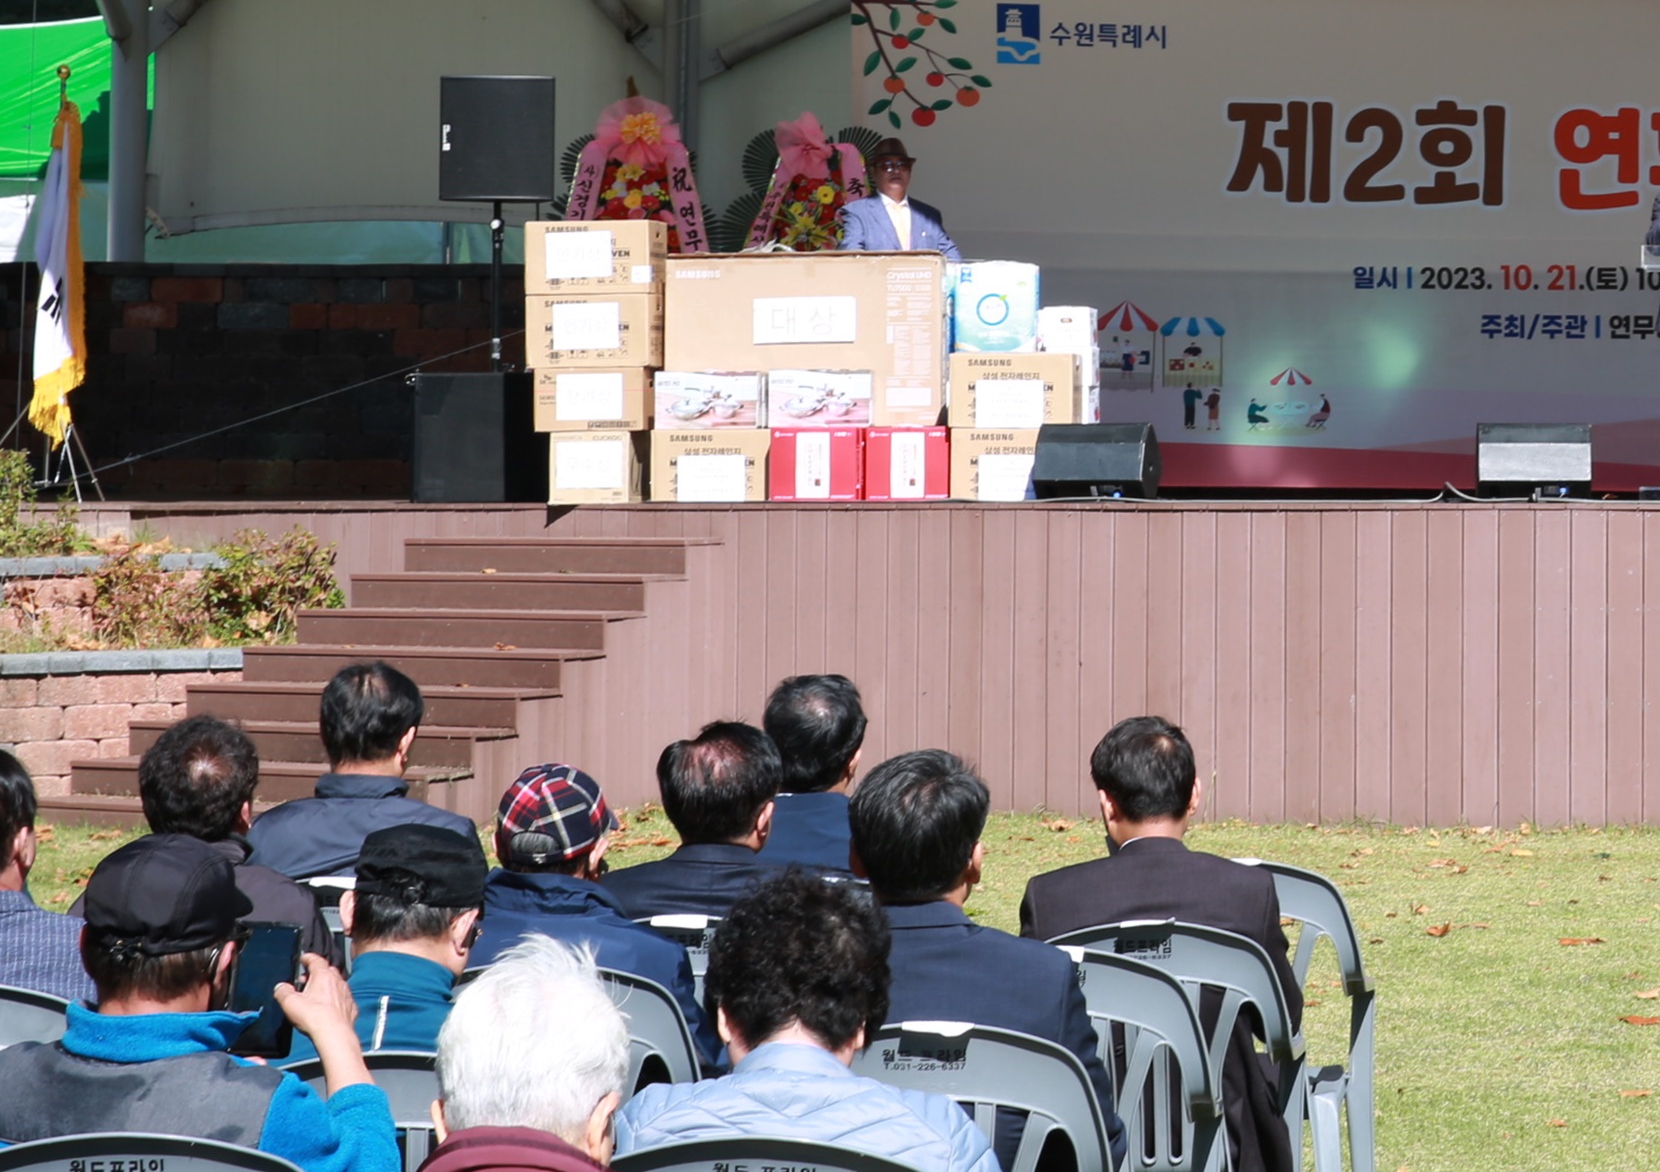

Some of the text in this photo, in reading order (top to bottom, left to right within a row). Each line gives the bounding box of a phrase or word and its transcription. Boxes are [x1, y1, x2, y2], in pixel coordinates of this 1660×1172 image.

[1049, 21, 1167, 50] 수원특례시
[1226, 98, 1508, 208] 제2회
[847, 178, 866, 197] 축
[1352, 265, 1399, 290] 일시
[1420, 266, 1493, 291] 2023.
[1499, 264, 1539, 291] 10.
[1480, 314, 1588, 340] 주최/주관
[669, 434, 713, 442] SAMSUNG
[970, 433, 1014, 441] SAMSUNG
[884, 1062, 966, 1071] T.031-226-6337
